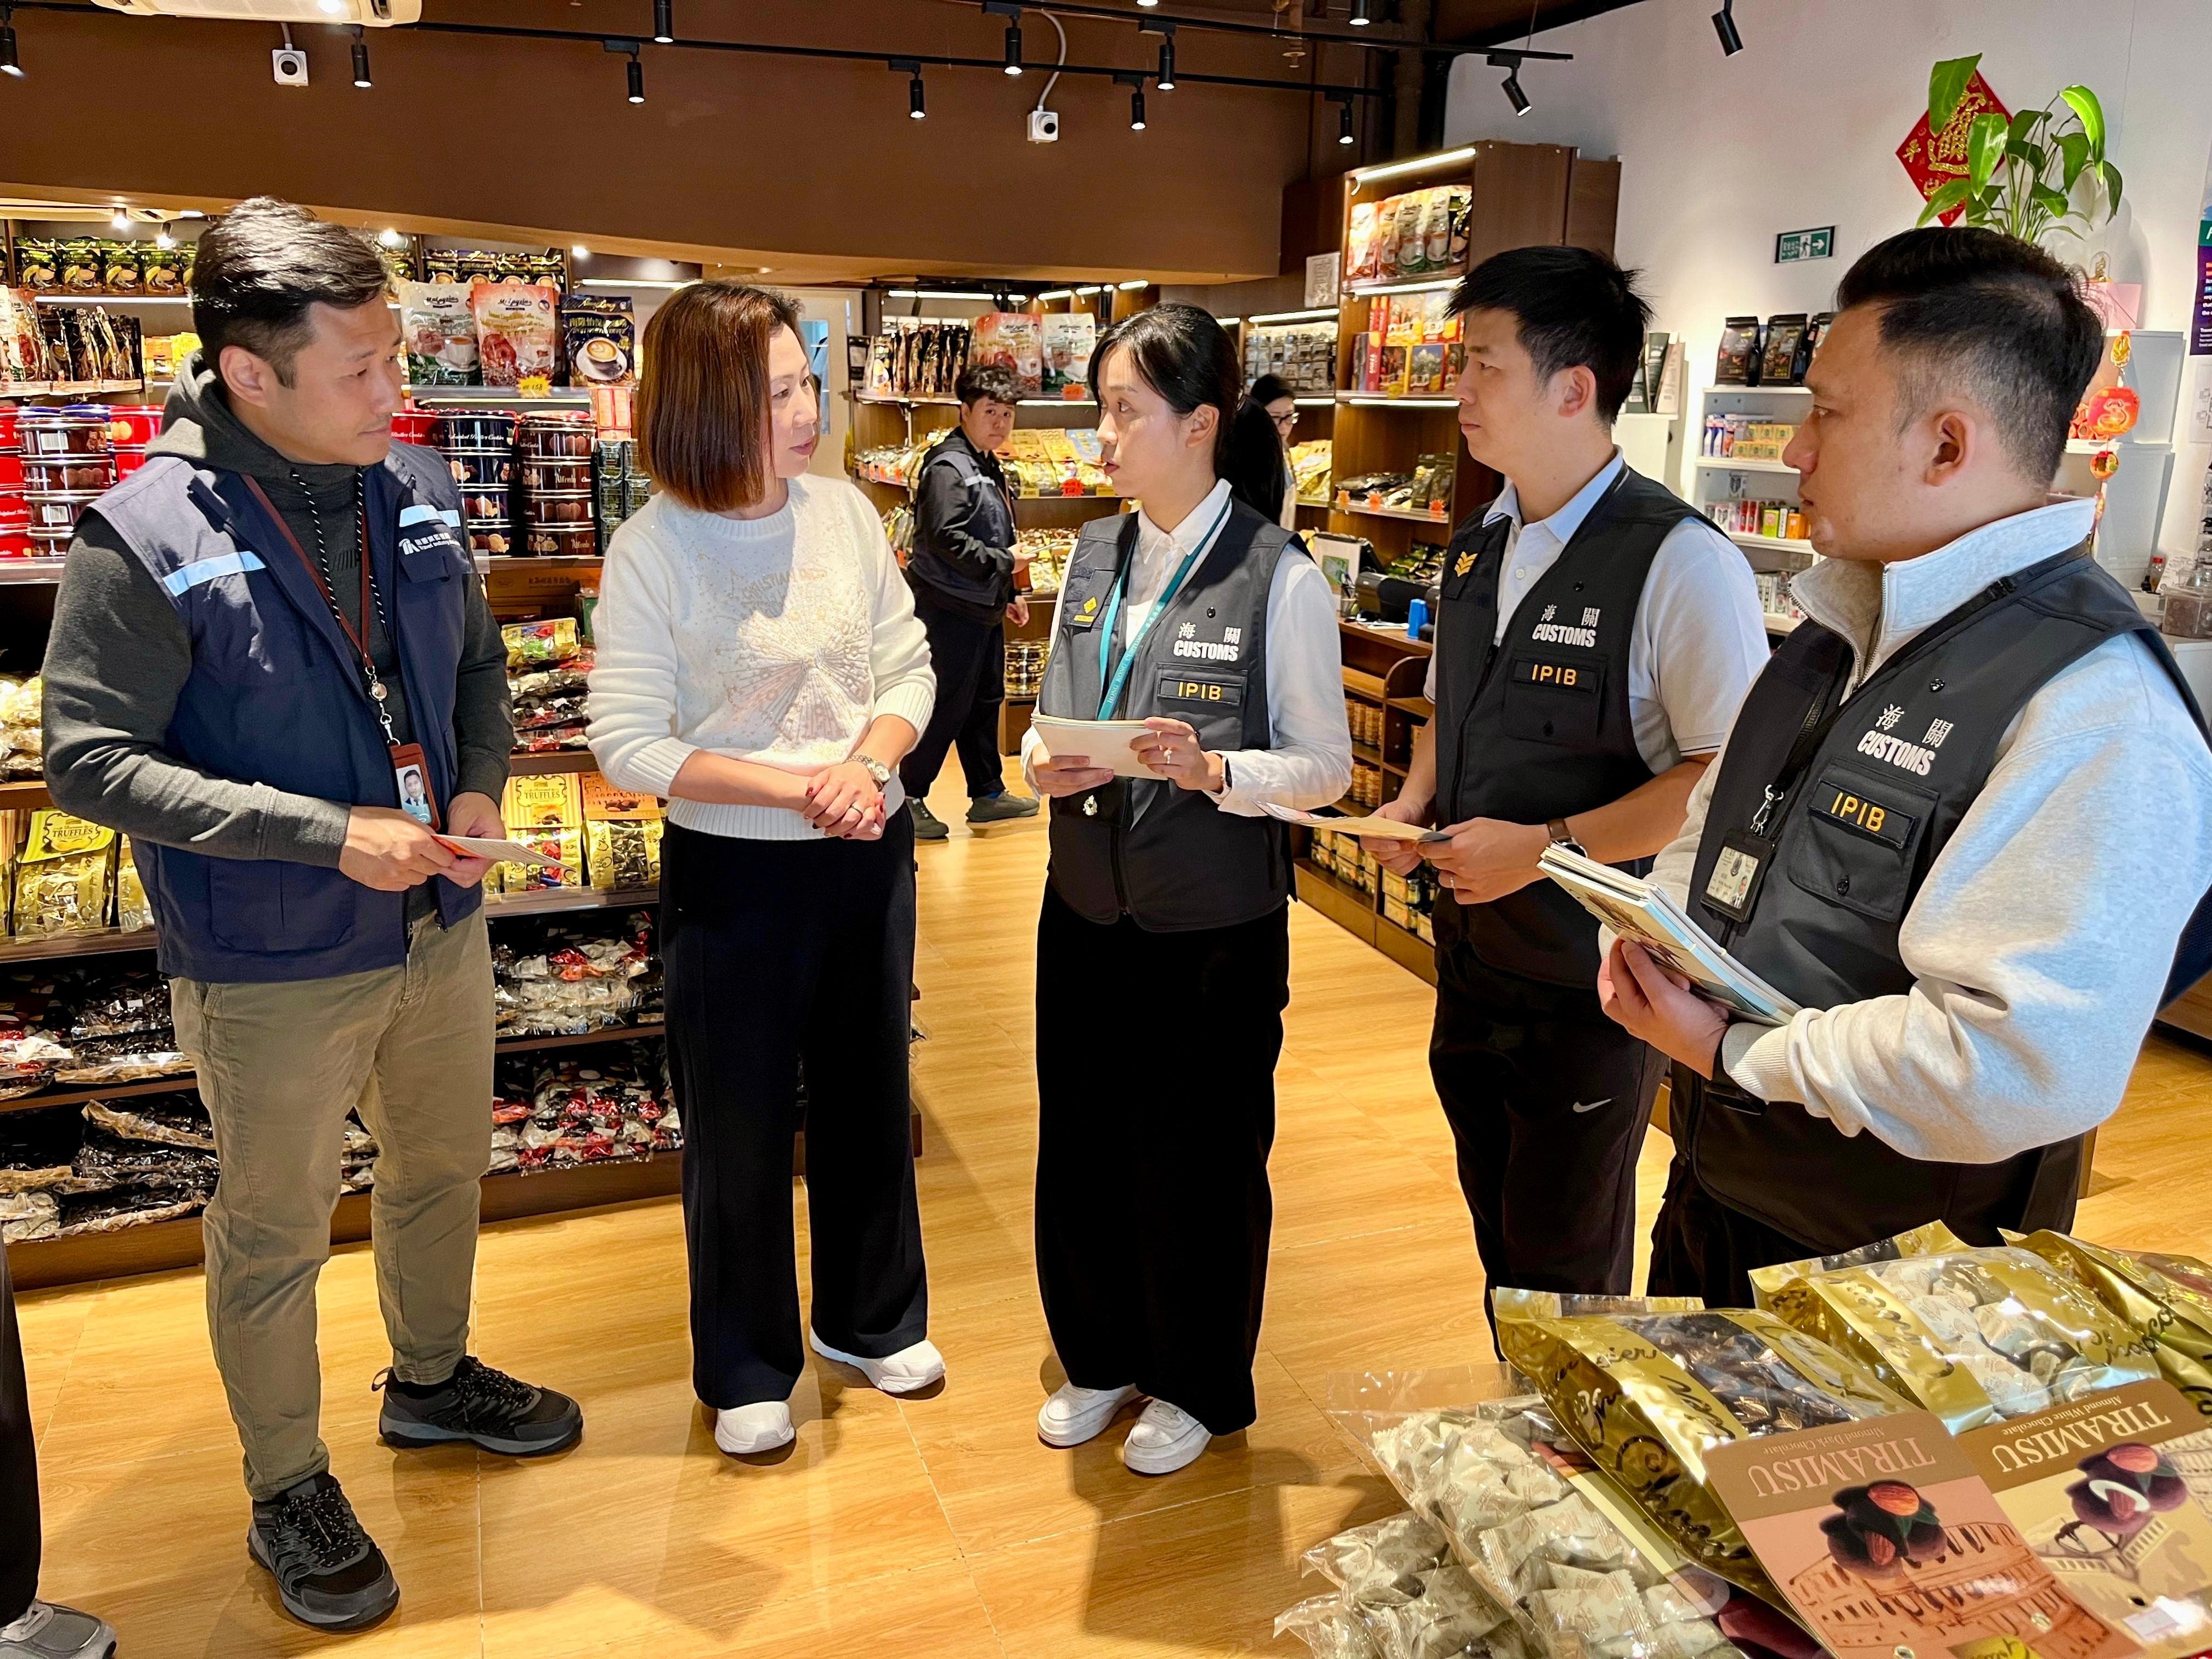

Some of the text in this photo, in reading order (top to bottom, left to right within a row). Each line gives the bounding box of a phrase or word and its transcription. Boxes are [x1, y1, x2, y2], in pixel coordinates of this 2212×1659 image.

[1532, 624, 1596, 648] CUSTOMS
[1173, 640, 1239, 662] CUSTOMS
[1532, 664, 1576, 685] IPIB
[1178, 681, 1221, 700] IPIB
[1857, 730, 1936, 776] CUSTOMS
[524, 791, 560, 799] TRUFFLES
[1831, 792, 1885, 832] IPIB
[52, 828, 93, 838] TRUFFLES
[2001, 1395, 2123, 1436] Almond White Chocolate
[1763, 1426, 1885, 1454] Almond Dark Chocolate
[1993, 1402, 2171, 1472] TIRAMISU
[1748, 1437, 1937, 1497] TIRAMISU
